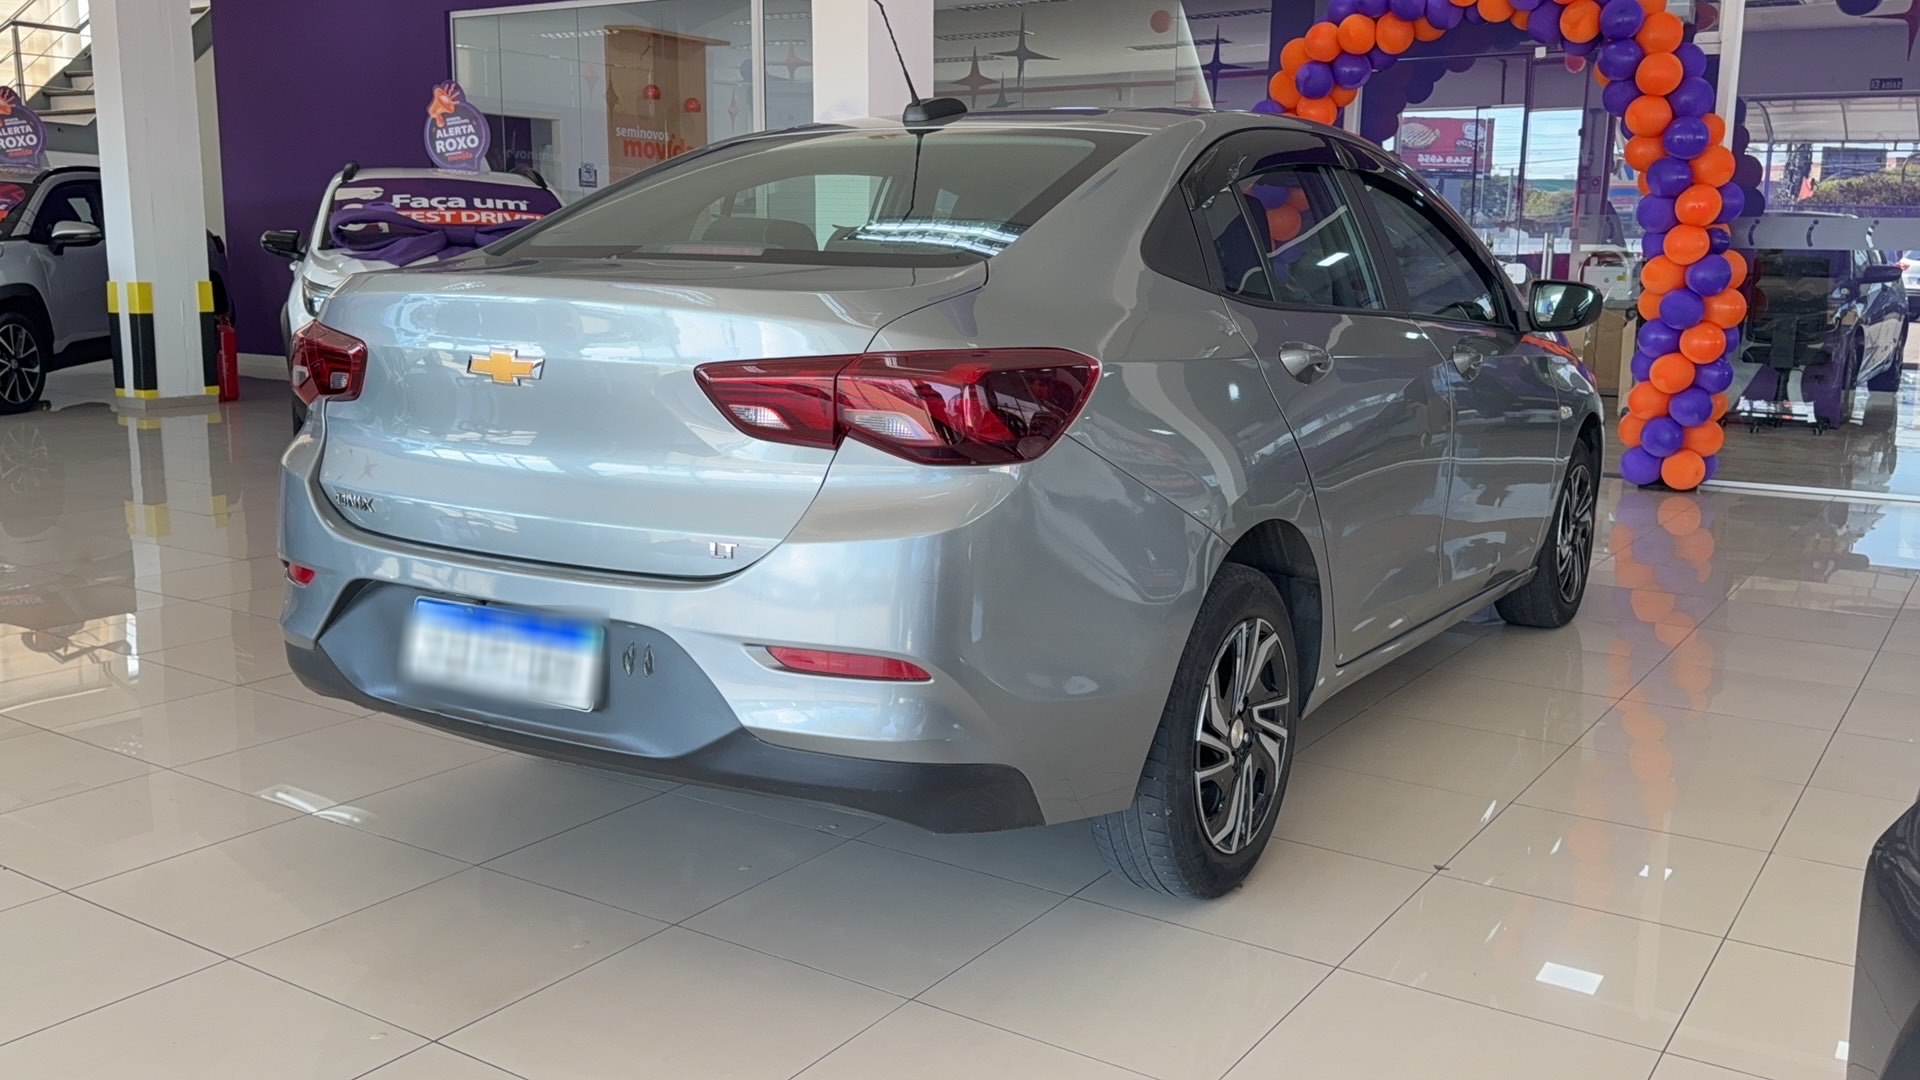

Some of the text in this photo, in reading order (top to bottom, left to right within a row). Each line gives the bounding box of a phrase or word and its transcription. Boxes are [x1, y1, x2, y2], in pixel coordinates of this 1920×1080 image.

[436, 124, 475, 139] ALERTA
[615, 126, 669, 141] seminovos
[435, 134, 479, 154] ROXO
[392, 194, 528, 211] Faça um
[709, 542, 740, 560] LT
